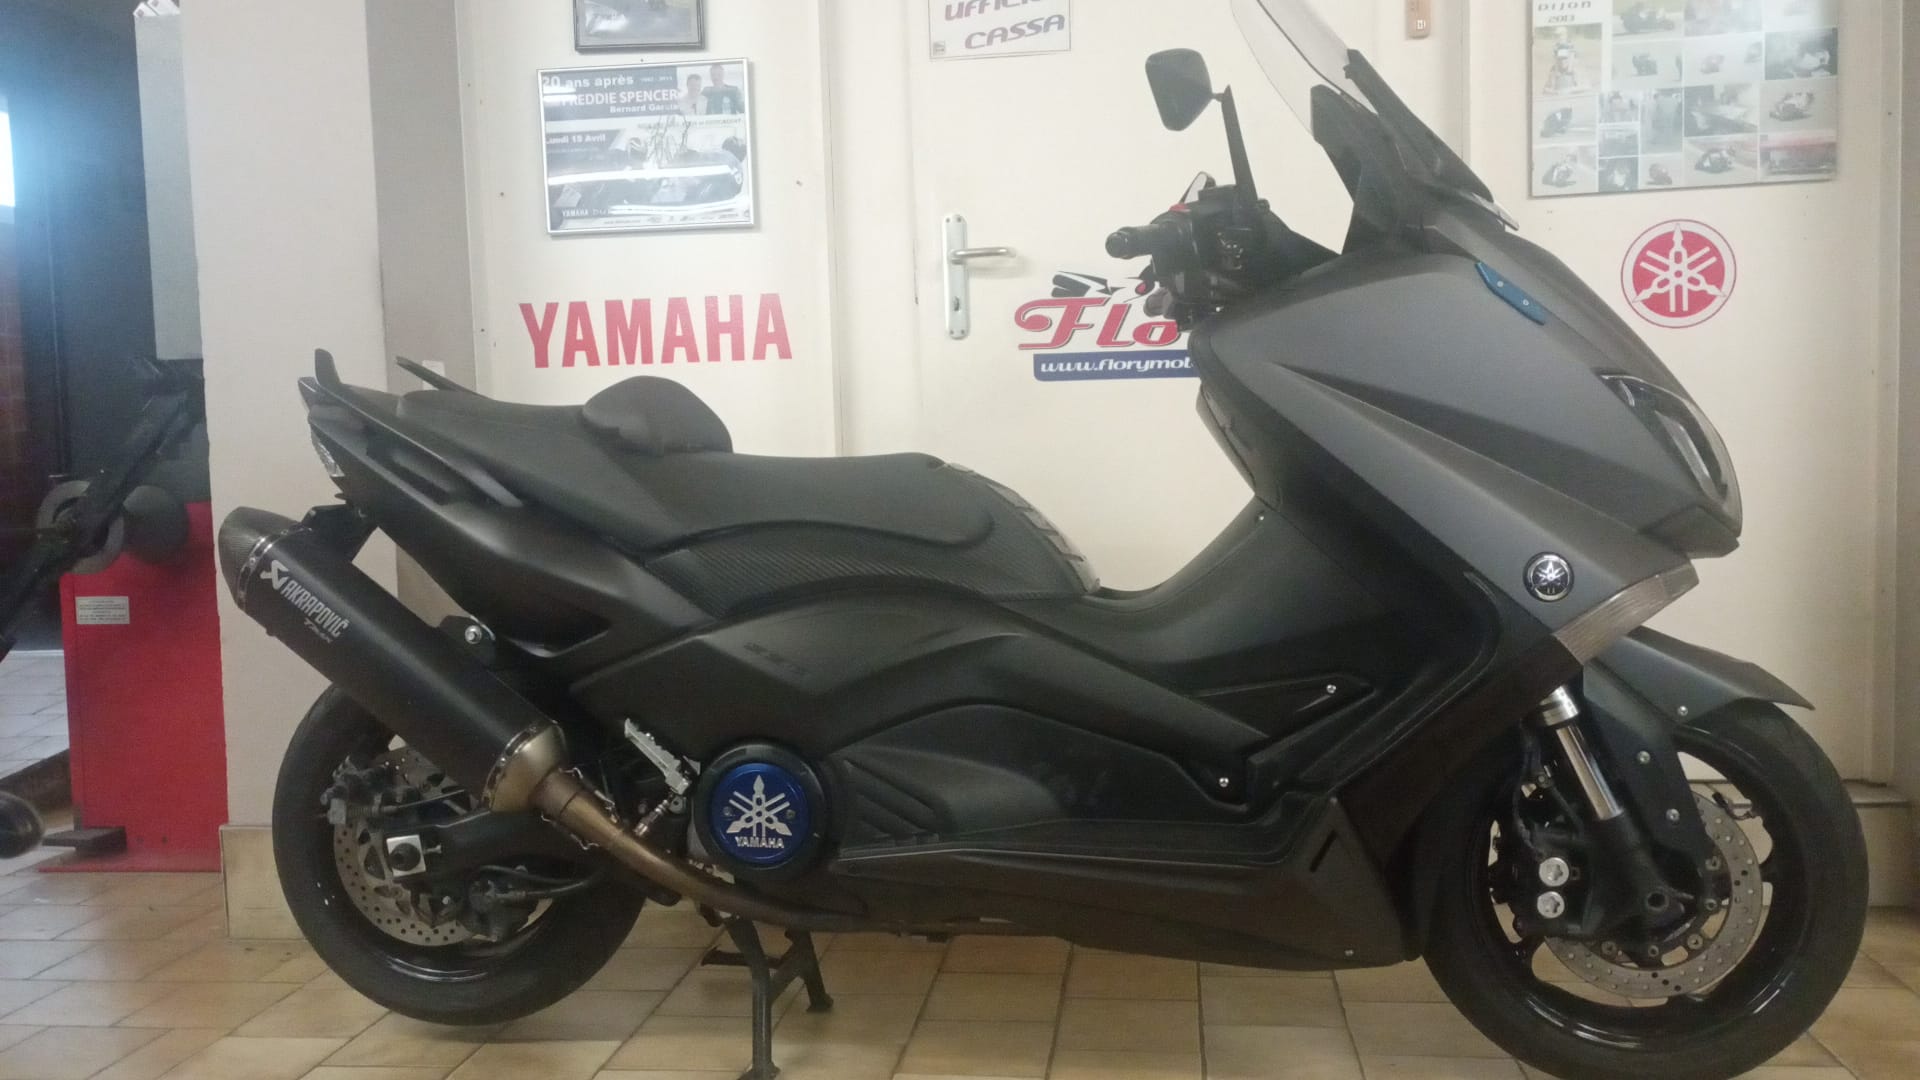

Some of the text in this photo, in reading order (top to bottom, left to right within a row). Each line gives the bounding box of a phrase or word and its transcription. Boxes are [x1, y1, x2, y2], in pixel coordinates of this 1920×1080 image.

[965, 14, 1065, 49] CASSA
[543, 76, 560, 87] 20
[565, 79, 590, 88] ans
[594, 75, 634, 89] après
[619, 89, 680, 104] SPENCER
[610, 105, 646, 113] Bernard
[585, 134, 606, 143] Avril
[519, 293, 793, 368] YAMAHA
[1040, 357, 1194, 373] www.florymot
[735, 836, 784, 849] YAMAHA
